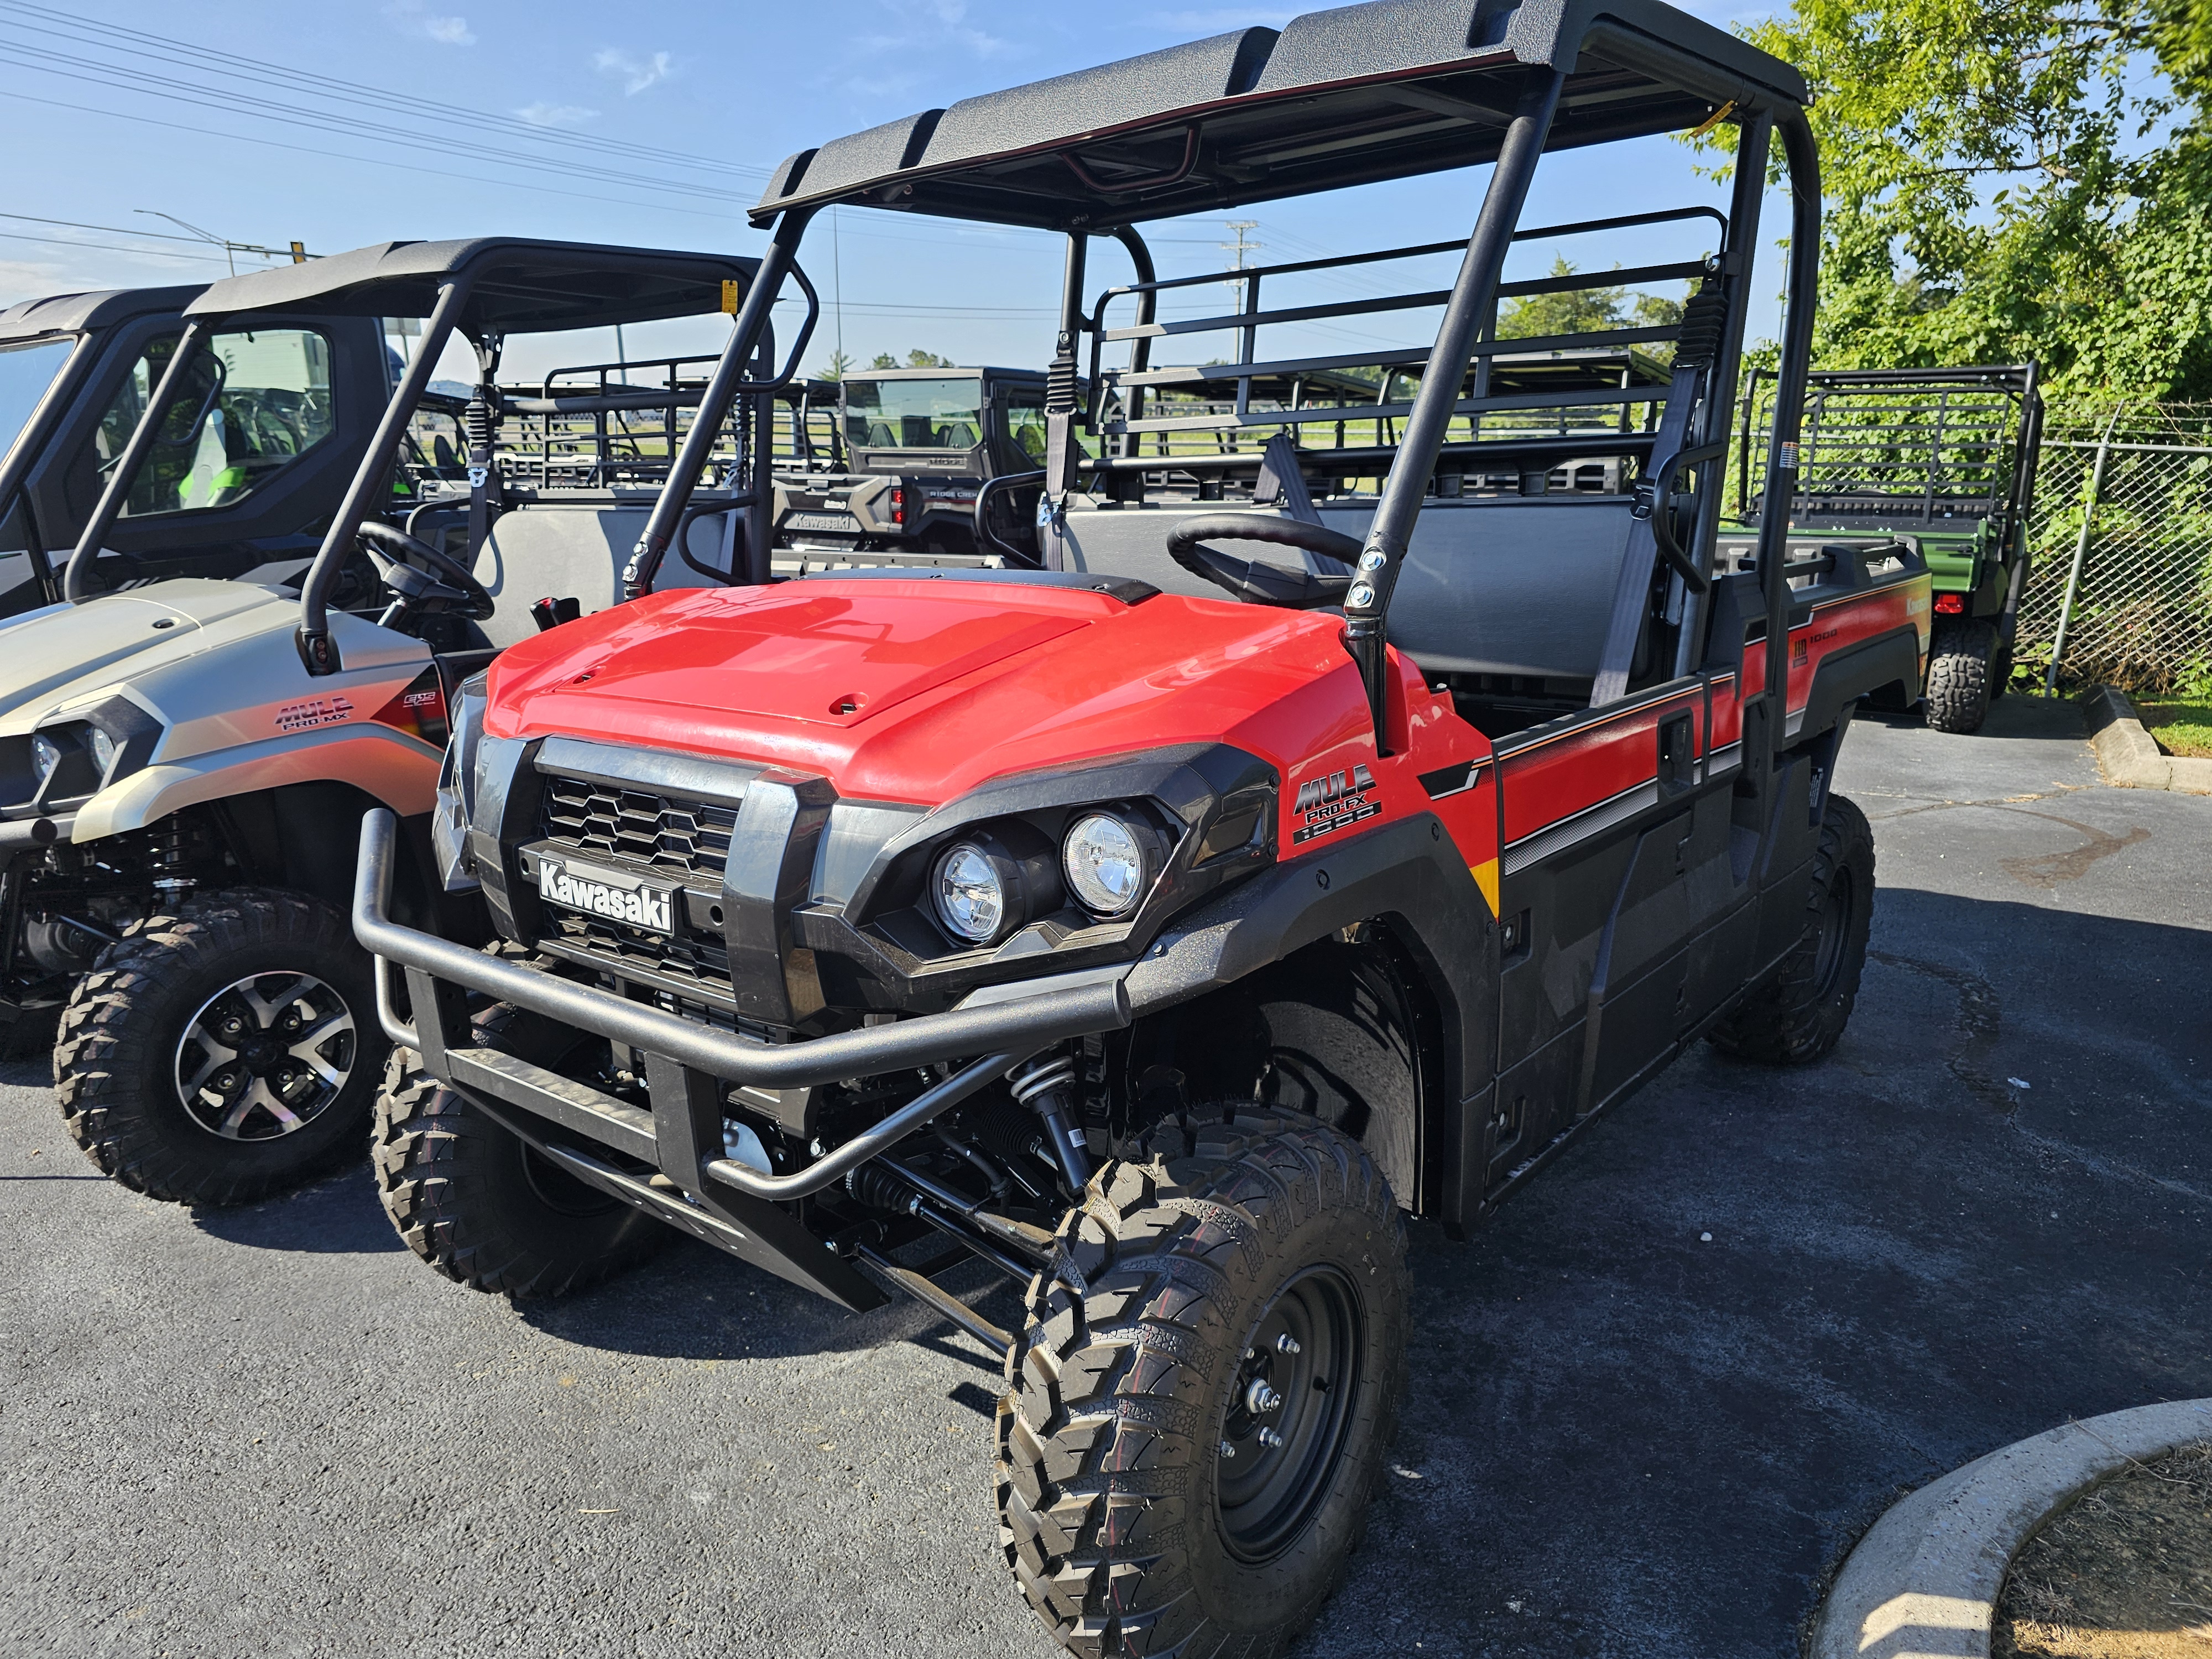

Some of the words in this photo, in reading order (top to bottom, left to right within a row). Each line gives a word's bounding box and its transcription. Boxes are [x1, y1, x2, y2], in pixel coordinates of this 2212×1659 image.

[796, 514, 849, 529] Kawasaki
[1811, 629, 1837, 643] 1000
[275, 697, 354, 724] MULE
[404, 692, 436, 705] EPS
[283, 712, 348, 731] PRO-MX
[1293, 764, 1378, 817] MULE
[1302, 805, 1374, 839] 1000
[1306, 793, 1368, 825] PRO-FX
[539, 861, 671, 931] Kawasaki
